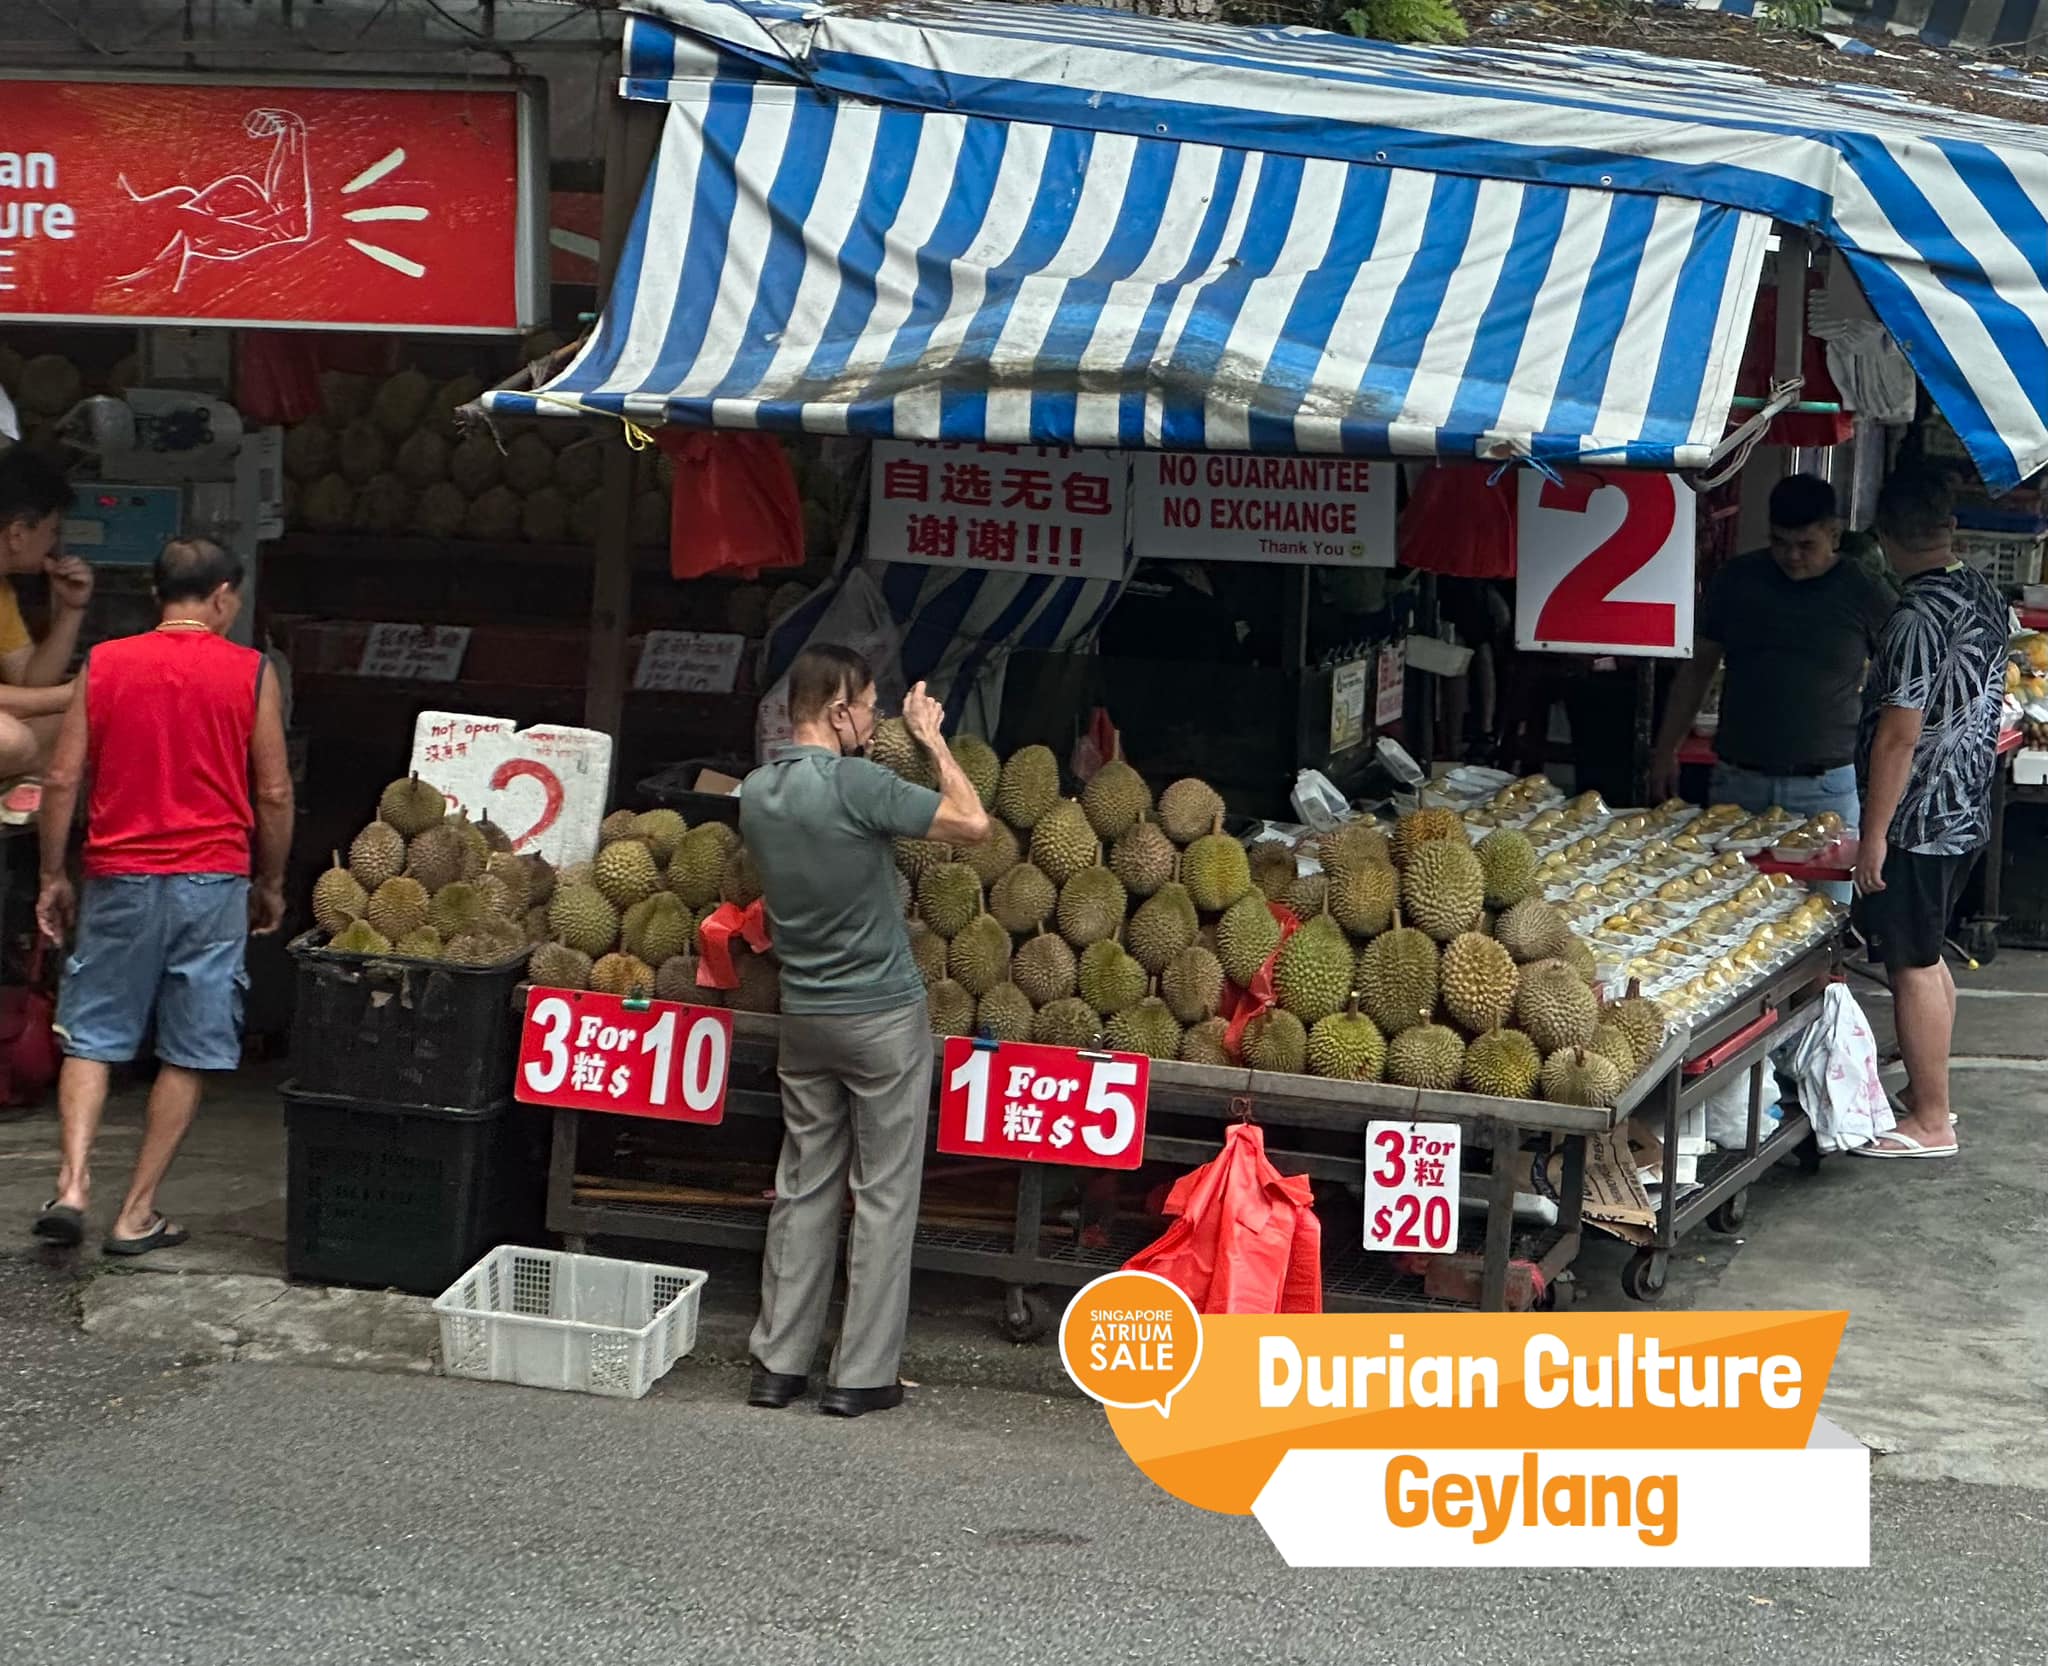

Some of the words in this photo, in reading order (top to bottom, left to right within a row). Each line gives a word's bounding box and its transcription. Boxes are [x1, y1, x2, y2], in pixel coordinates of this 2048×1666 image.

[884, 457, 1113, 516] 自选无包
[1159, 454, 1197, 486] NO
[1206, 456, 1370, 493] GUARANTEE
[1164, 497, 1202, 528] NO
[1210, 498, 1357, 535] EXCHANGE
[1260, 538, 1308, 555] Thank
[1314, 540, 1344, 557] You
[1534, 469, 1677, 648] 2
[431, 719, 456, 742] not
[464, 723, 500, 742] open
[524, 997, 572, 1093] 3
[575, 1015, 637, 1052] For
[571, 1052, 607, 1092] 粒
[950, 1049, 991, 1143] 1
[1004, 1066, 1080, 1102] For
[1003, 1101, 1044, 1143] 粒
[1373, 1130, 1406, 1188] 3
[1408, 1135, 1455, 1156] For
[1414, 1158, 1445, 1187] 粒
[1371, 1194, 1451, 1249] $20
